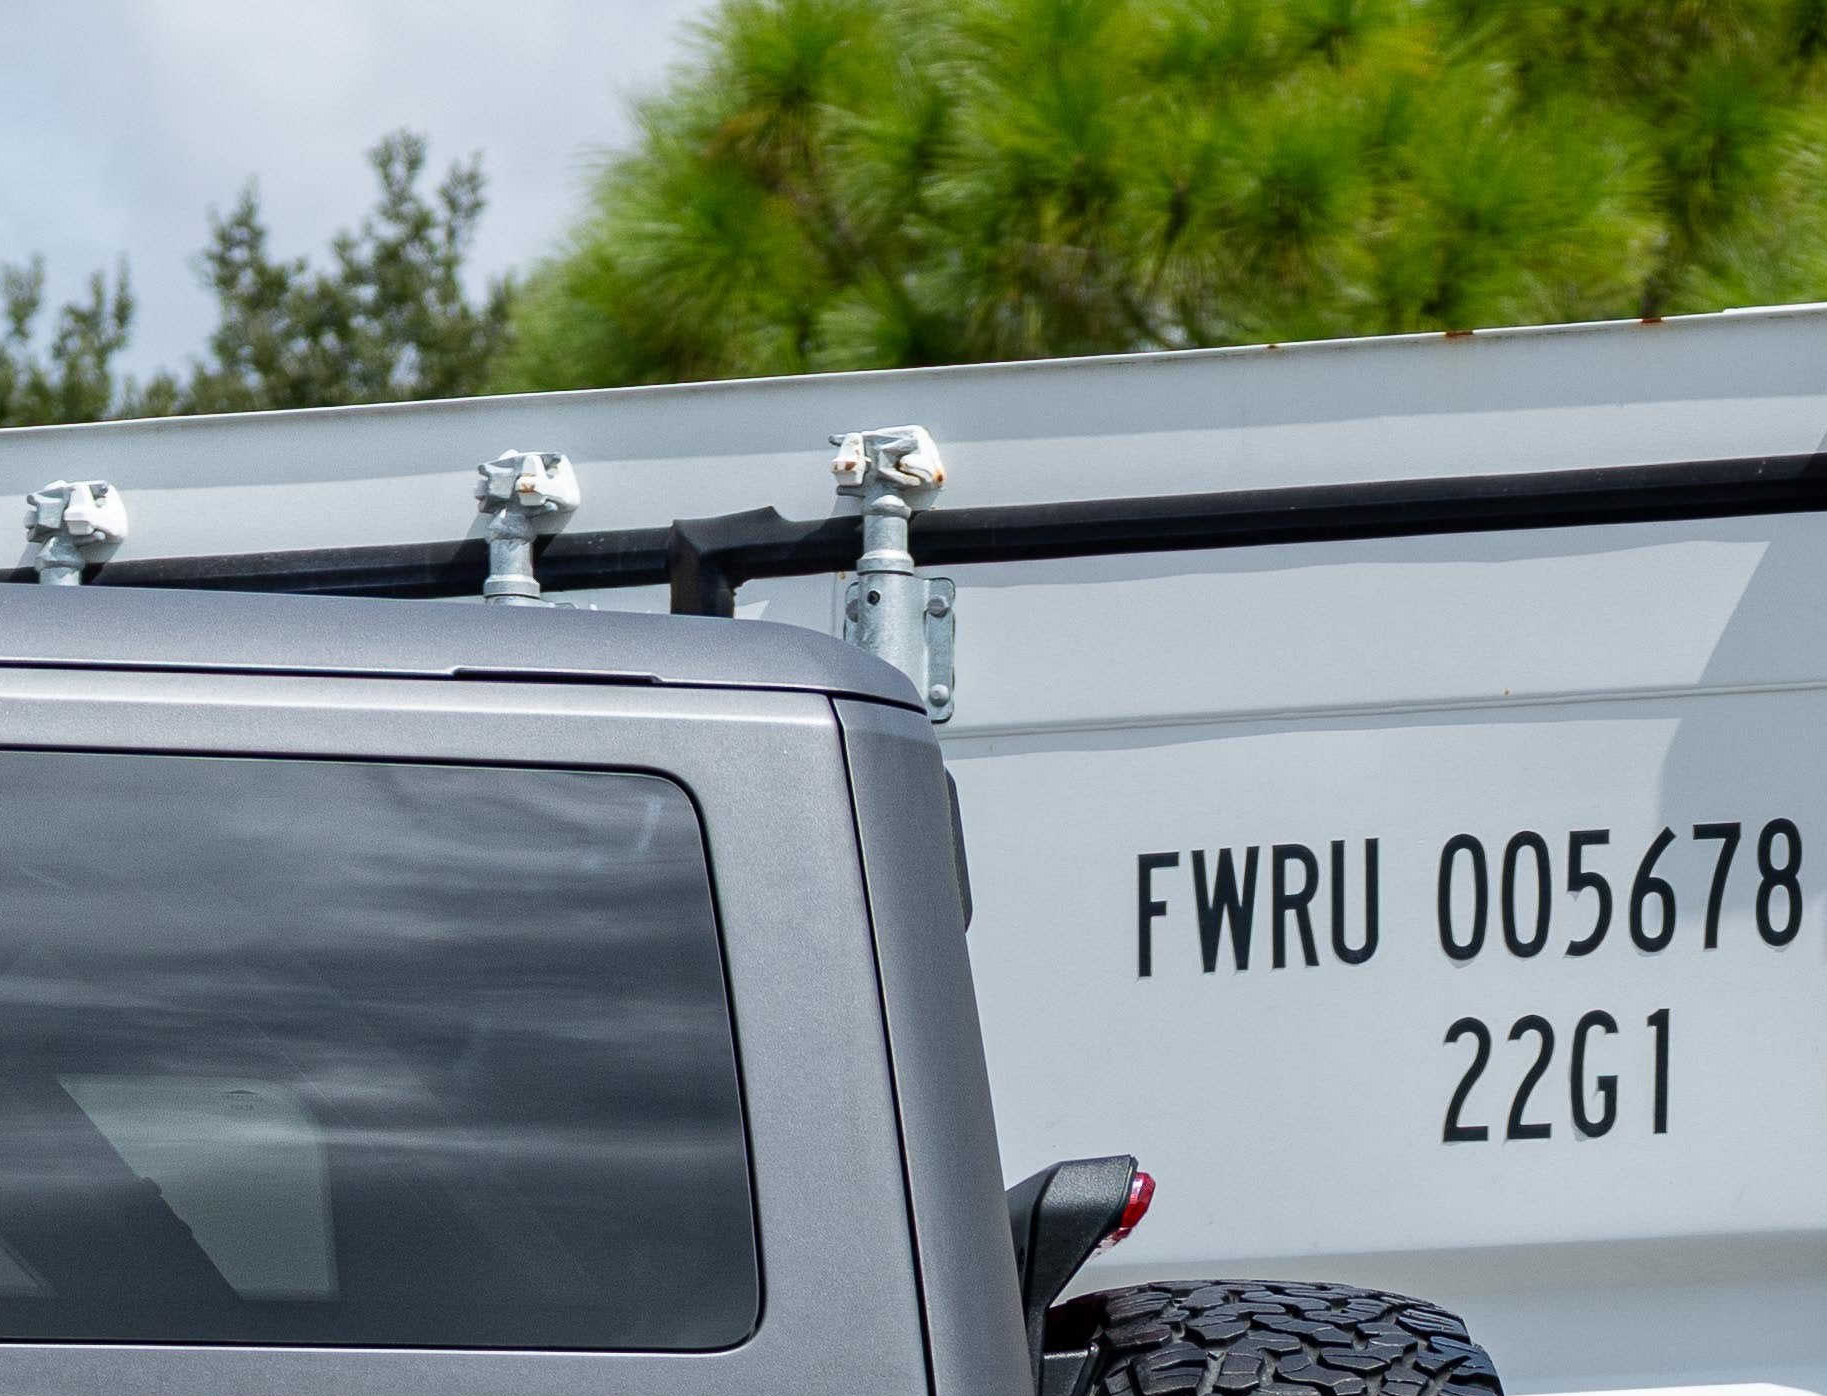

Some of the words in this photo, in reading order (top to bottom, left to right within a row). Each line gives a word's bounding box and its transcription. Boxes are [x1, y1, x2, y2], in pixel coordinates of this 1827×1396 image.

[1136, 838, 1380, 979] FWRU
[1437, 817, 1804, 962] 005678
[1442, 1008, 1670, 1143] 22G1
